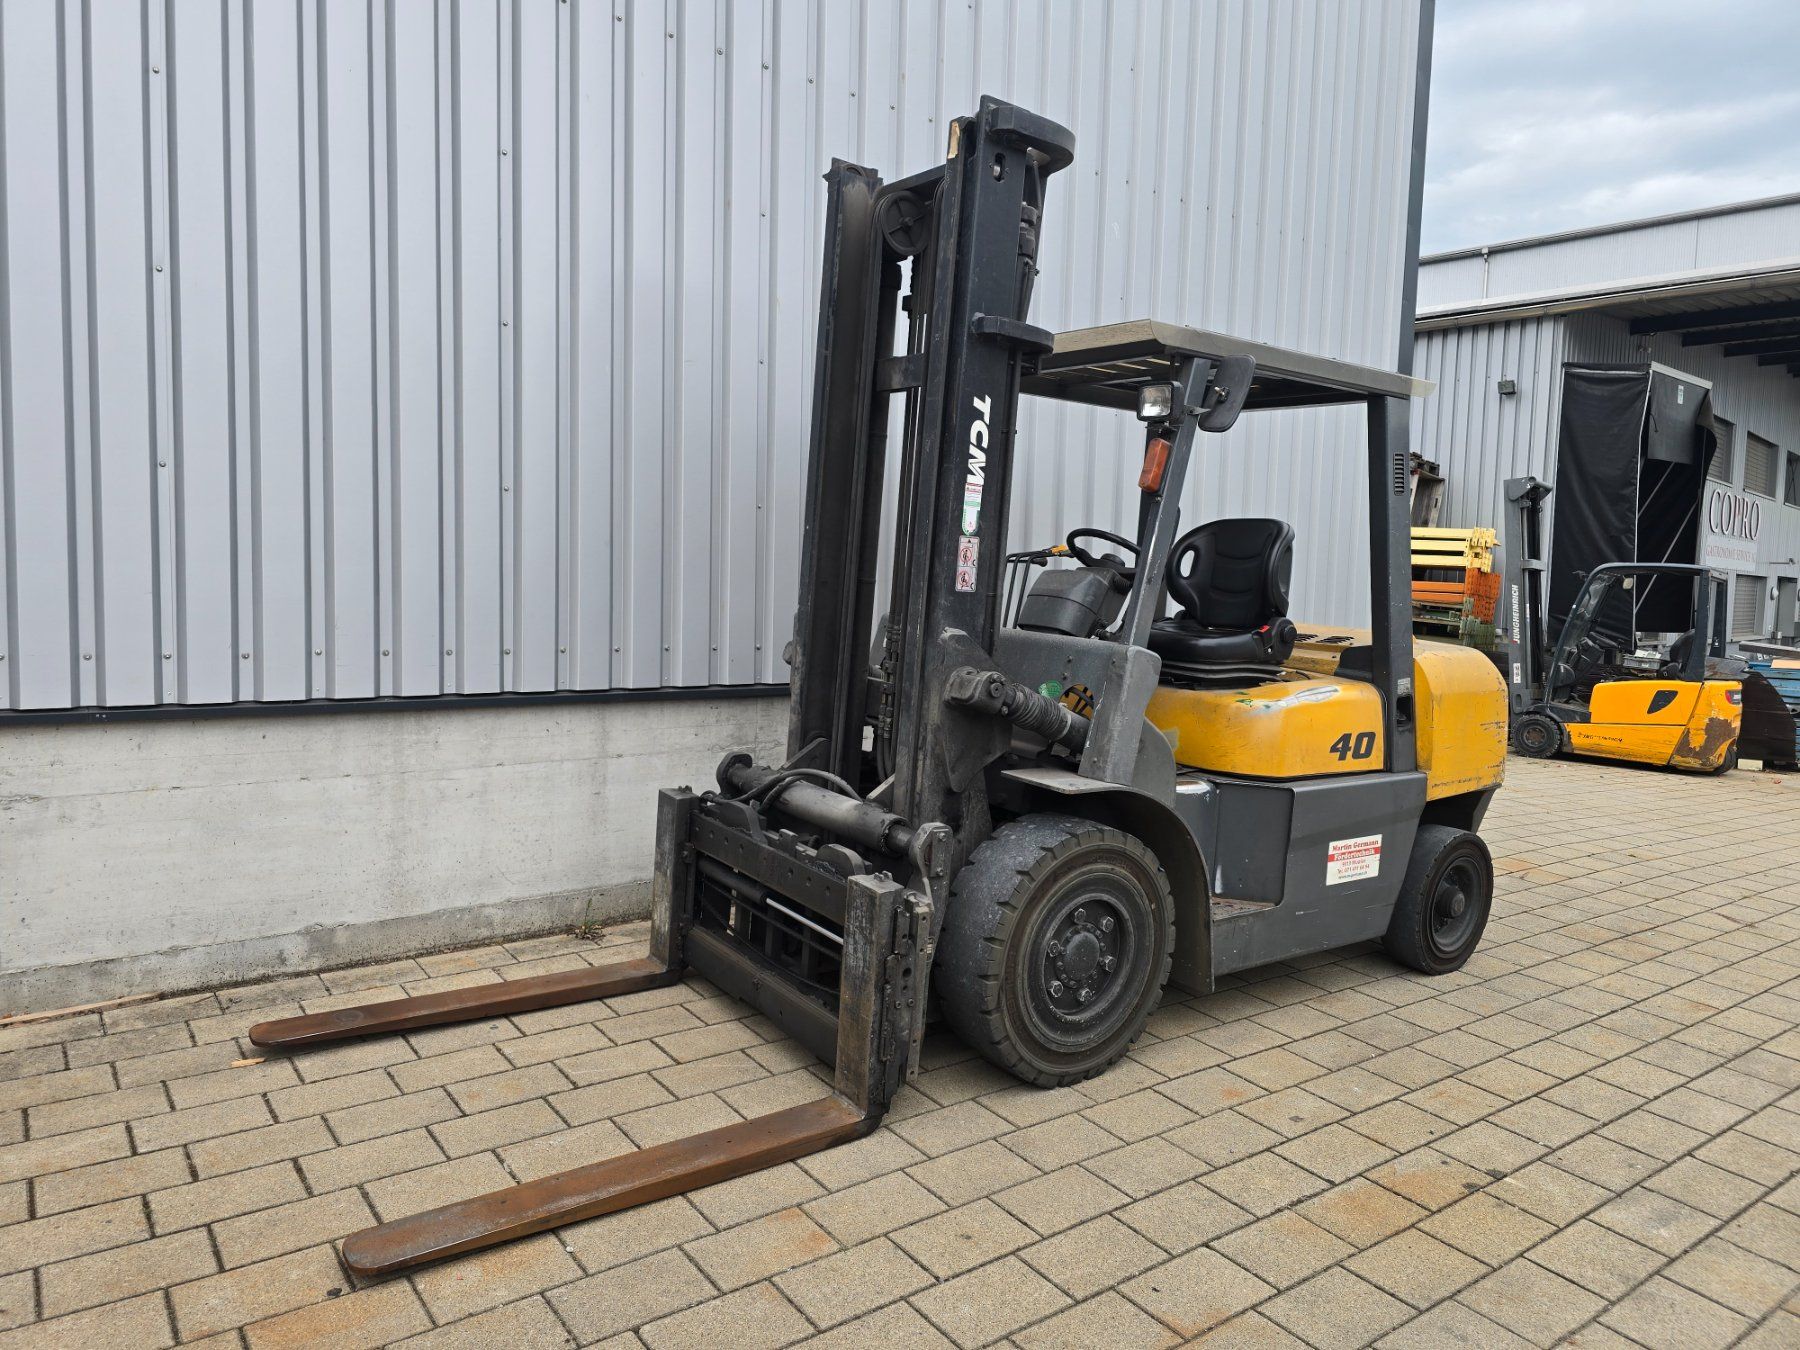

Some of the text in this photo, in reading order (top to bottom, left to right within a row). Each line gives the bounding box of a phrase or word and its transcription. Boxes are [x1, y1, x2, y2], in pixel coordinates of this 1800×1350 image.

[966, 395, 992, 486] TCM
[1708, 488, 1760, 541] COPRO
[1511, 584, 1521, 644] JUNGHEINRICH
[1329, 731, 1377, 762] 40
[1332, 843, 1352, 852] Martin
